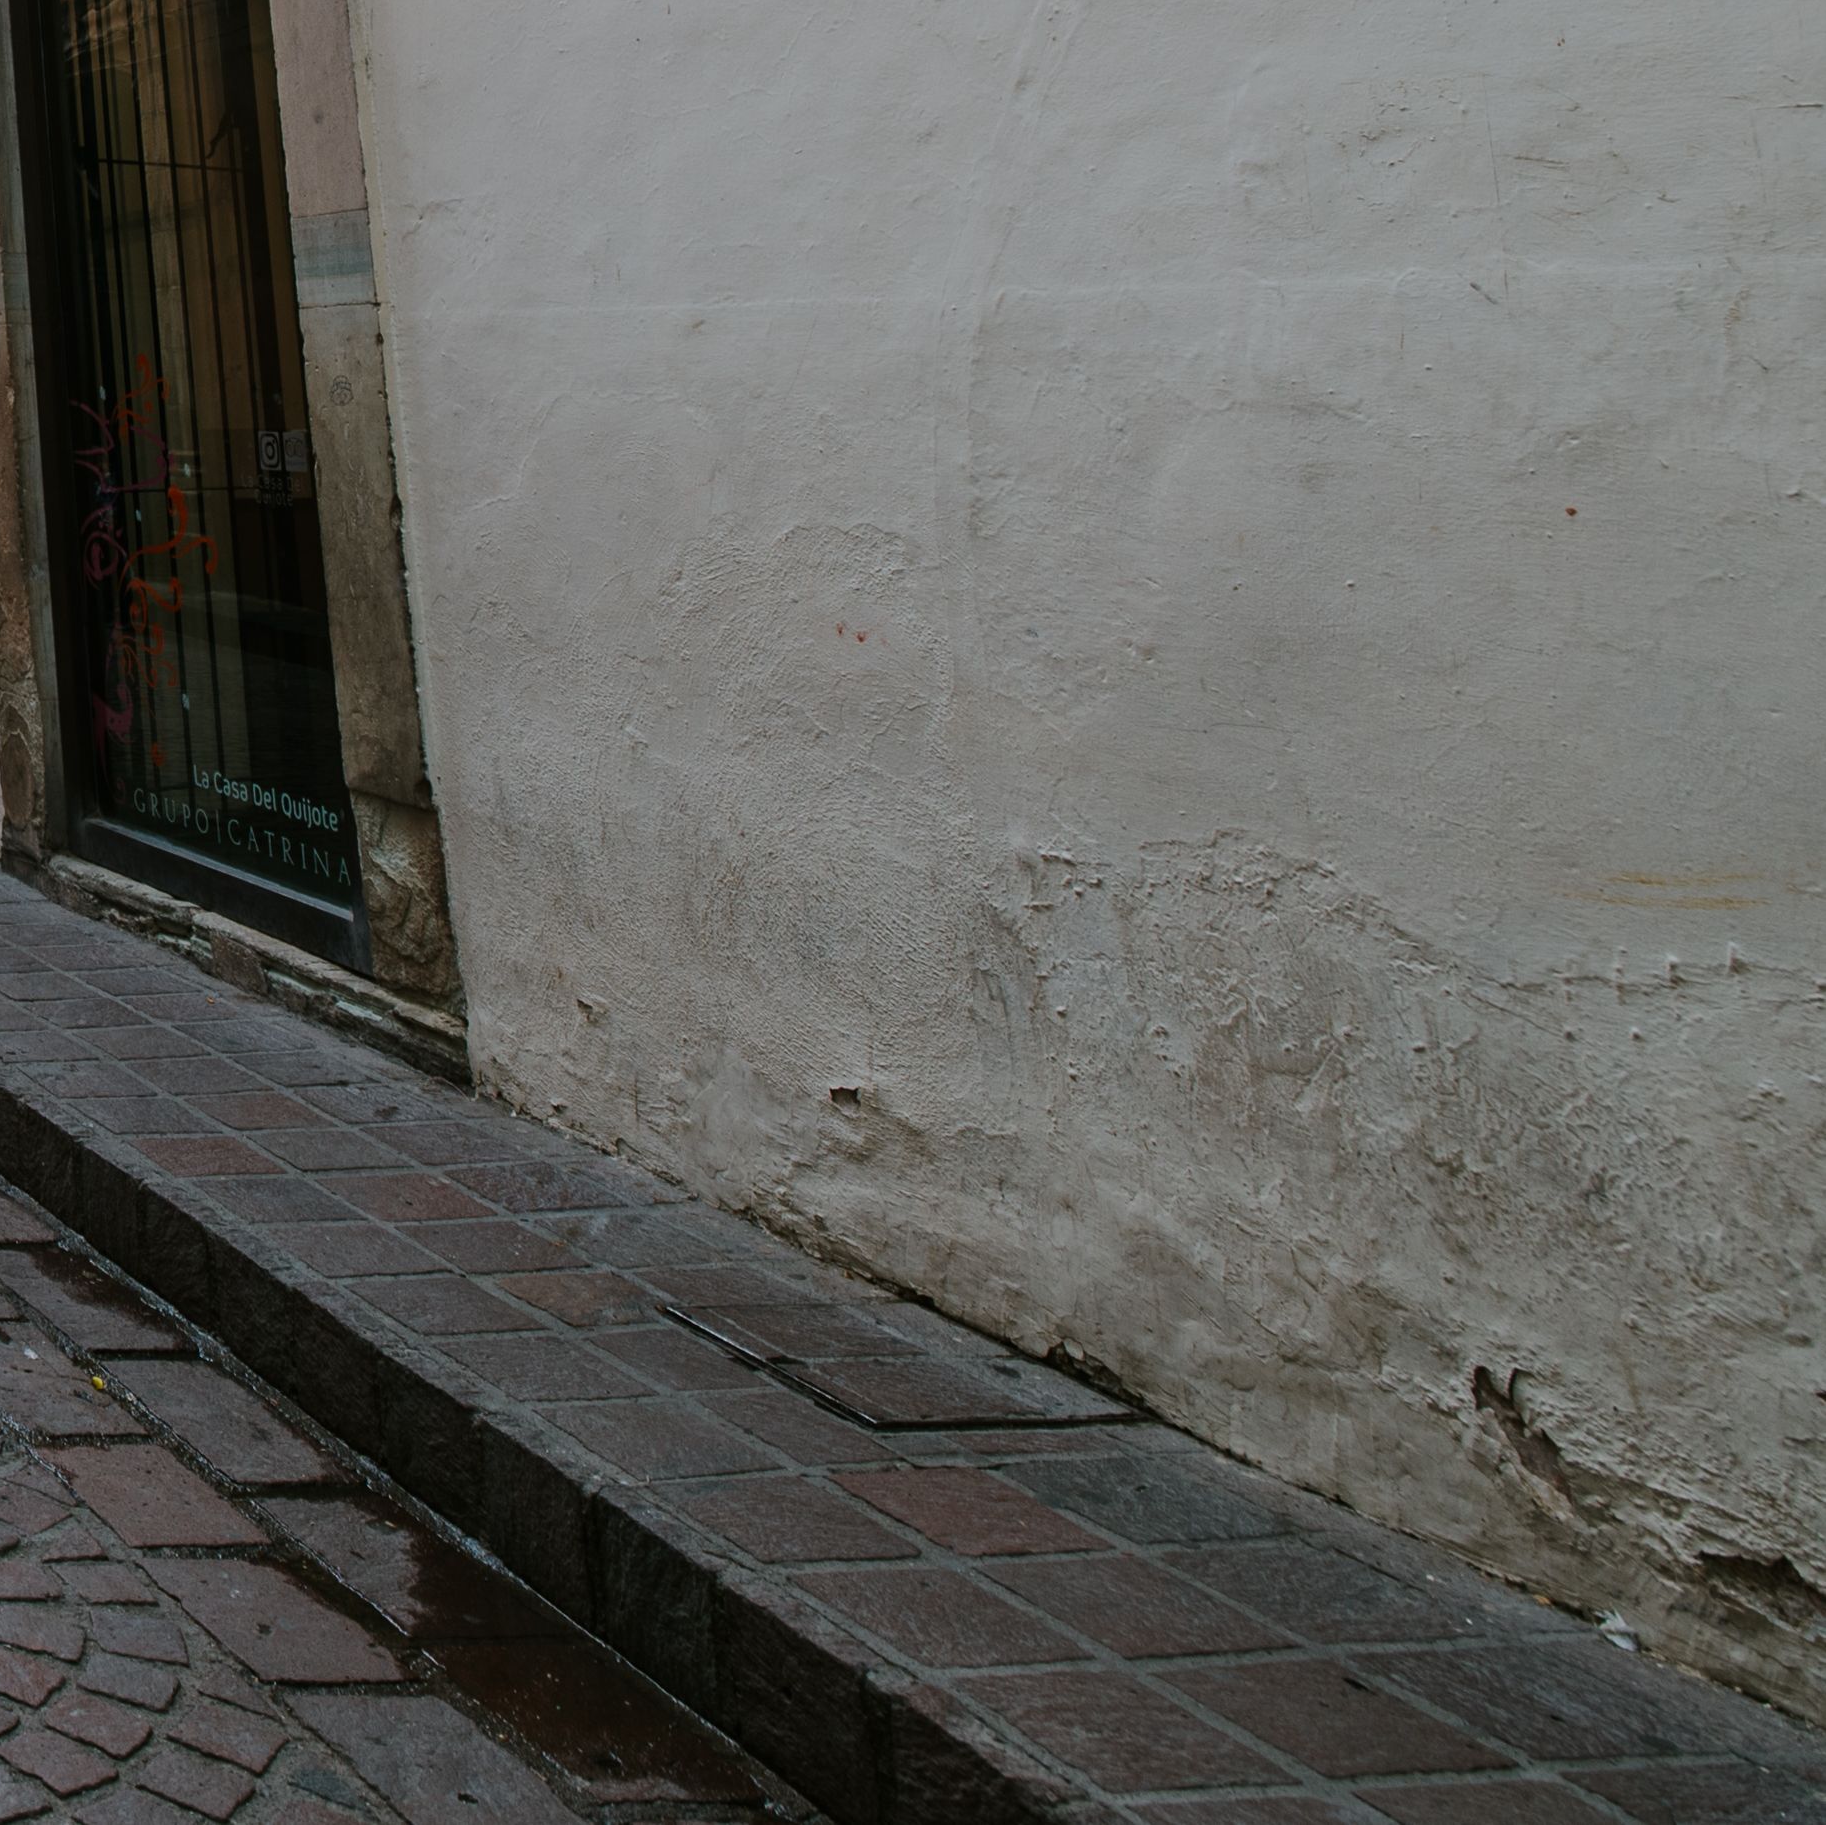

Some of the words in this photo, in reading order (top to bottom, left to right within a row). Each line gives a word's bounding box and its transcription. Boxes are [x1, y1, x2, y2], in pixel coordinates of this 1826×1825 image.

[133, 787, 209, 835] GRUPO
[227, 818, 351, 887] CATRINA
[193, 764, 210, 789] La
[213, 772, 248, 803] Casa
[252, 782, 277, 813] Del
[281, 791, 339, 832] Quijote
